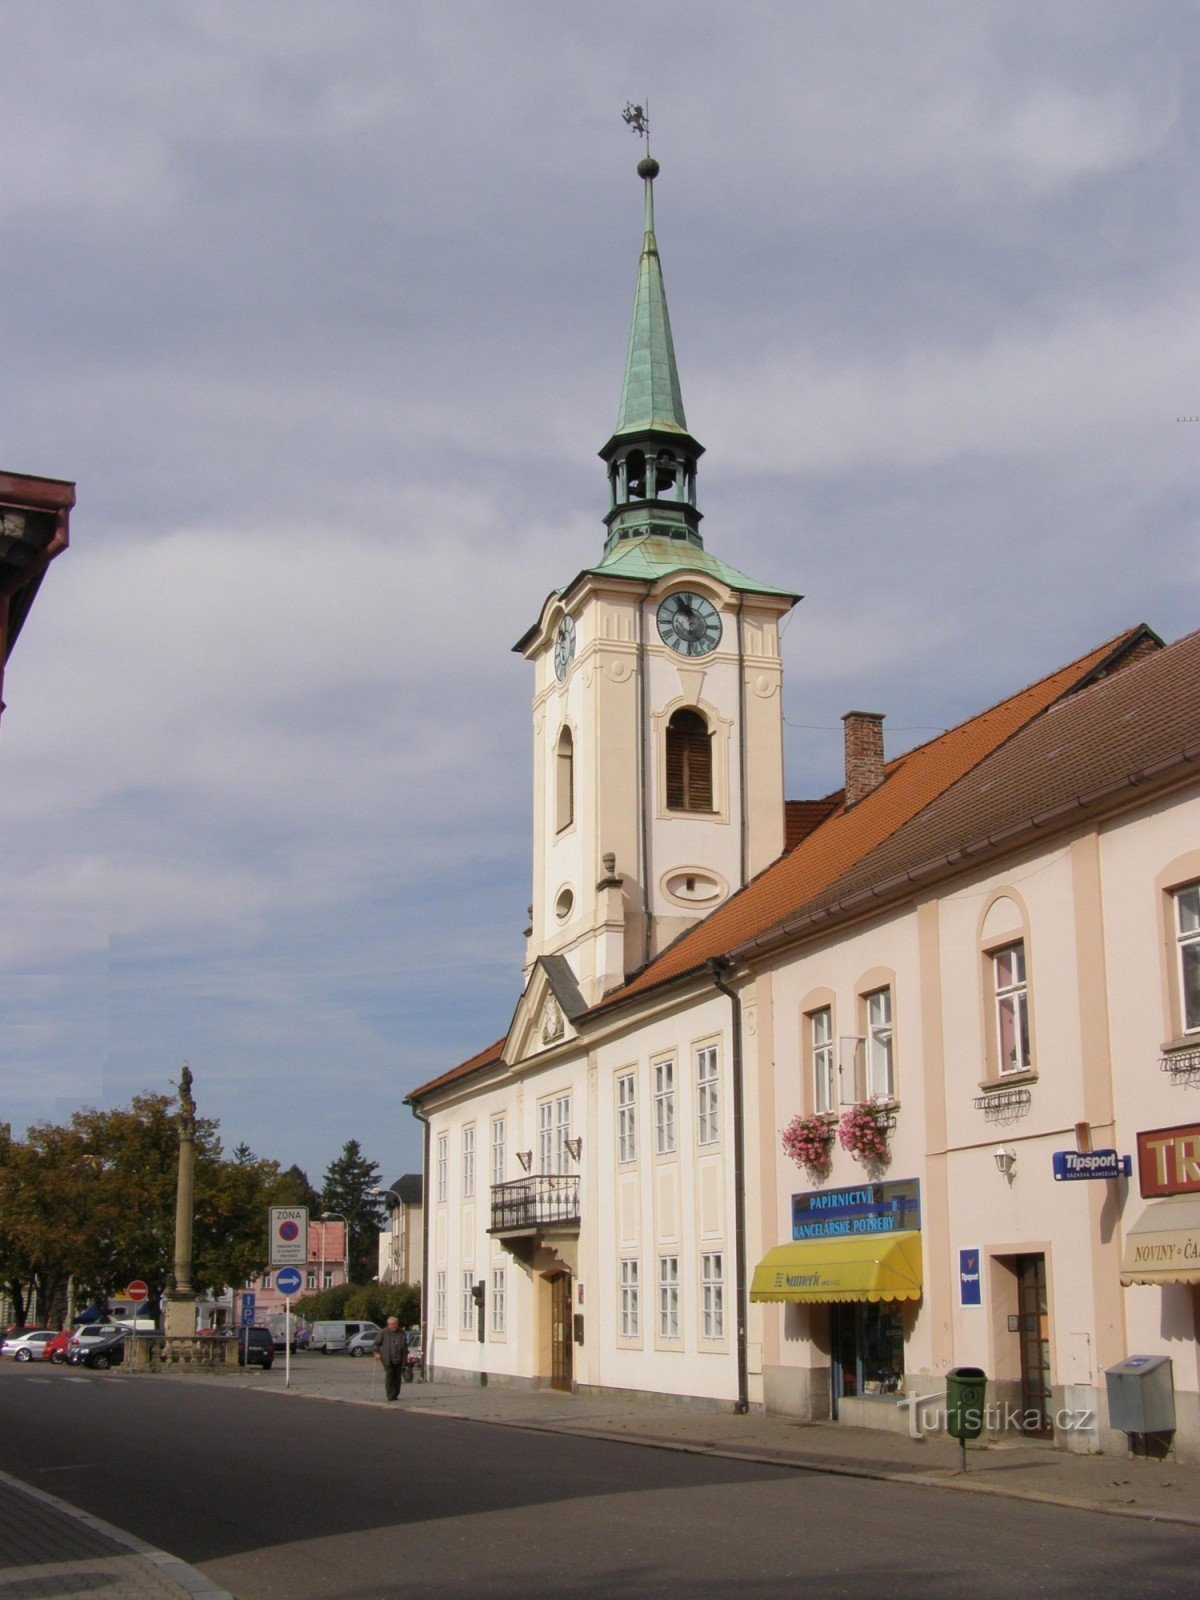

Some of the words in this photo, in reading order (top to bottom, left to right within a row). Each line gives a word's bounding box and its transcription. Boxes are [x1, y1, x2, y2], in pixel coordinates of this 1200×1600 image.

[1065, 1153, 1116, 1170] Tipsport
[276, 1209, 301, 1220] ZÓNA
[853, 1214, 895, 1232] POTŘEBY
[1134, 1245, 1176, 1262] NOVINY
[1183, 1238, 1200, 1259] ČA
[961, 1272, 979, 1282] Tipsport
[244, 1309, 253, 1319] P
